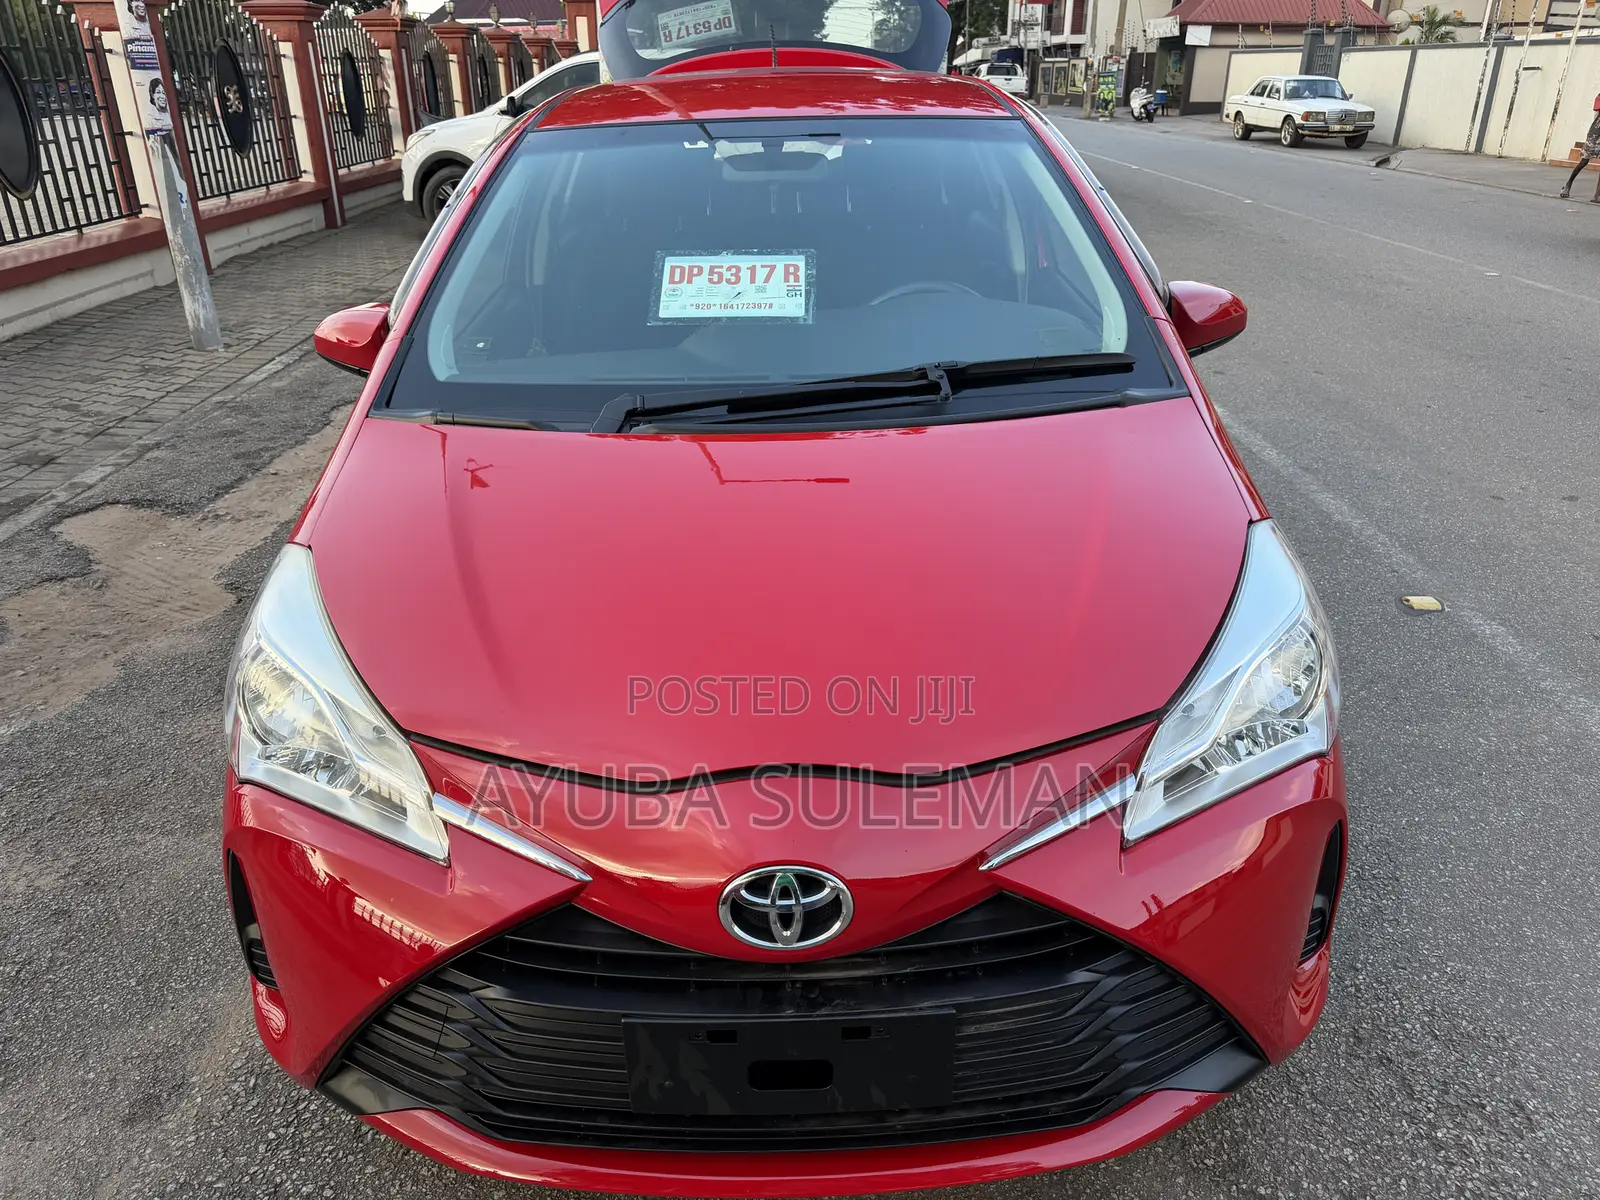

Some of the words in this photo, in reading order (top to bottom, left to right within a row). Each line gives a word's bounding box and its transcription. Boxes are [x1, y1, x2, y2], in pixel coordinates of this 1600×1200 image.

[676, 20, 712, 40] 5317
[713, 16, 733, 30] DP
[663, 29, 673, 43] R
[668, 265, 704, 285] DP
[707, 264, 777, 285] 5317
[783, 263, 801, 284] R
